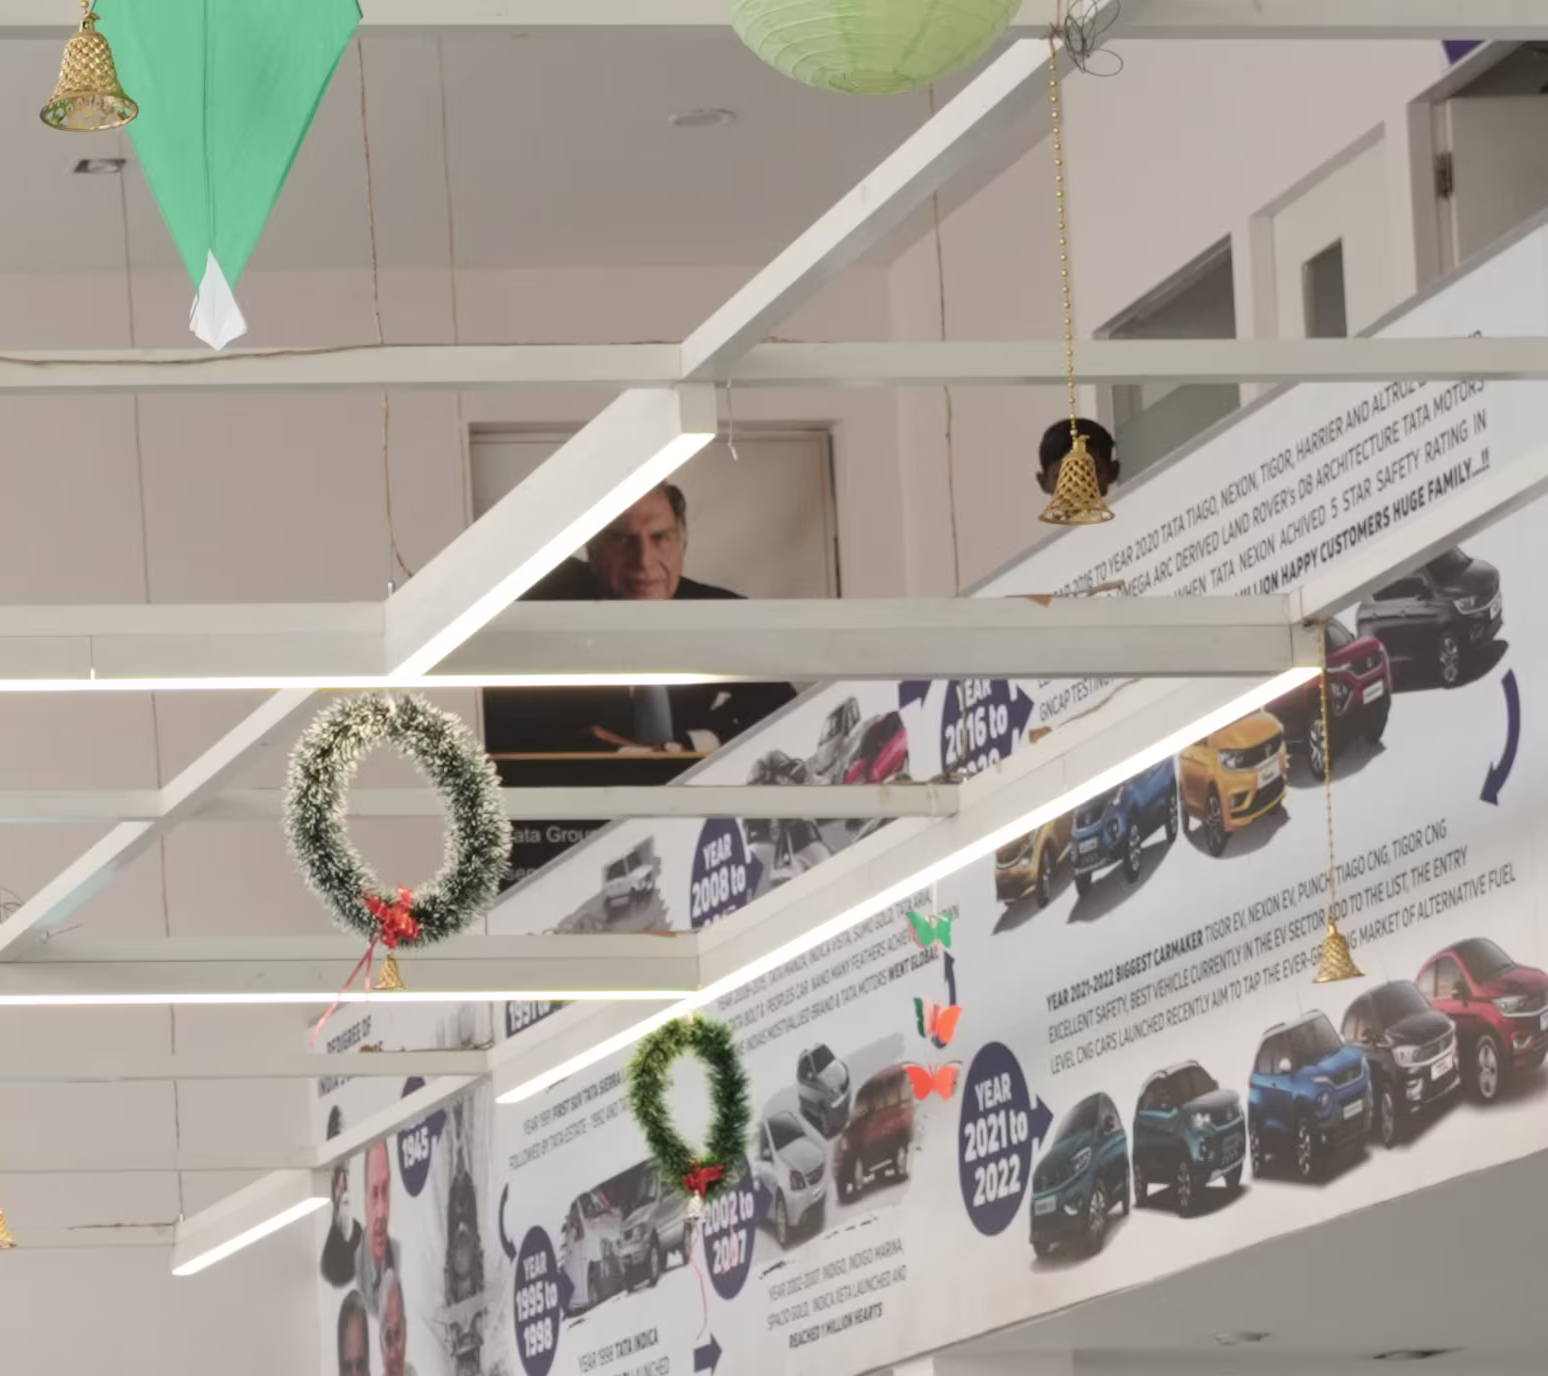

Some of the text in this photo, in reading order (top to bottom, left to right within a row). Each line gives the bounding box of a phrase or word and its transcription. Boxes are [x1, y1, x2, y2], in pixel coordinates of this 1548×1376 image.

[1108, 545, 1132, 575] YEAR
[1134, 529, 1158, 559] 2020
[1160, 513, 1184, 543] TATA
[1295, 415, 1343, 461] HARRIER
[1346, 399, 1369, 430] AND
[1154, 556, 1172, 583] ARC
[1175, 529, 1218, 571] DERIVED
[1221, 511, 1248, 543] LAND
[1316, 420, 1399, 487] ARCHITECTURE
[1401, 402, 1430, 436] TATA
[1432, 379, 1484, 418] MOTORS
[1209, 557, 1235, 589] TATA
[1239, 533, 1275, 571] NEXON
[1279, 503, 1324, 548] ACHIVED
[1330, 495, 1337, 519] 5
[1342, 476, 1371, 511] STAR
[1376, 448, 1418, 491] SAFETY
[1424, 419, 1467, 463] RATING
[1473, 407, 1486, 435] IN
[1281, 547, 1317, 585] HAPPY
[1320, 505, 1389, 563] CUSTOMERS
[1392, 484, 1425, 521] HUGE
[945, 706, 987, 766] 2016
[988, 703, 1008, 740] to
[703, 833, 732, 871] YEAR
[692, 866, 729, 918] 2008
[731, 864, 746, 896] to
[1047, 987, 1068, 1011] YEAR
[1070, 967, 1114, 1001] 2021-2022
[1116, 950, 1151, 981] BIGGEST
[1154, 927, 1203, 964] CARMAKER
[1204, 915, 1230, 942] TIGOR
[1248, 893, 1280, 923] NEXON
[1336, 855, 1364, 884] TIAGO
[1392, 829, 1422, 859] TIGOR
[1424, 819, 1446, 845] CNG
[888, 958, 909, 980] WENT
[1048, 1008, 1093, 1043] EXCELLENT
[1130, 982, 1152, 1008] BEST
[1154, 967, 1188, 998] VEHICLE
[1191, 944, 1240, 982] CURRENTLY
[1243, 938, 1252, 961] IN
[1254, 930, 1272, 955] THE
[1274, 924, 1286, 947] EV
[1288, 908, 1324, 941] SECTOR
[1348, 891, 1362, 915] TO
[1364, 882, 1383, 908] THE
[1410, 862, 1430, 889] THE
[1434, 846, 1467, 879] ENTRY
[1051, 861, 1515, 1073] LEVEL CNG CARS LAUNCHED RECENTLY AIM TO TAP THE MARKET OF ALTERNATIVE FUEL
[975, 1072, 1011, 1112] YEAR
[402, 1127, 429, 1168] 1945
[964, 1109, 1028, 1162] 2021 to
[973, 1154, 1020, 1206] 2022
[739, 1190, 754, 1221] to
[523, 1251, 548, 1281] YEAR
[713, 1228, 747, 1275] 2007
[516, 1280, 557, 1322] 1995 to
[788, 1325, 819, 1348] REACHED
[854, 1301, 882, 1325] HEARTS
[524, 1317, 552, 1358] 1998
[615, 1336, 632, 1359] TATA
[634, 1327, 658, 1352] INDICA
